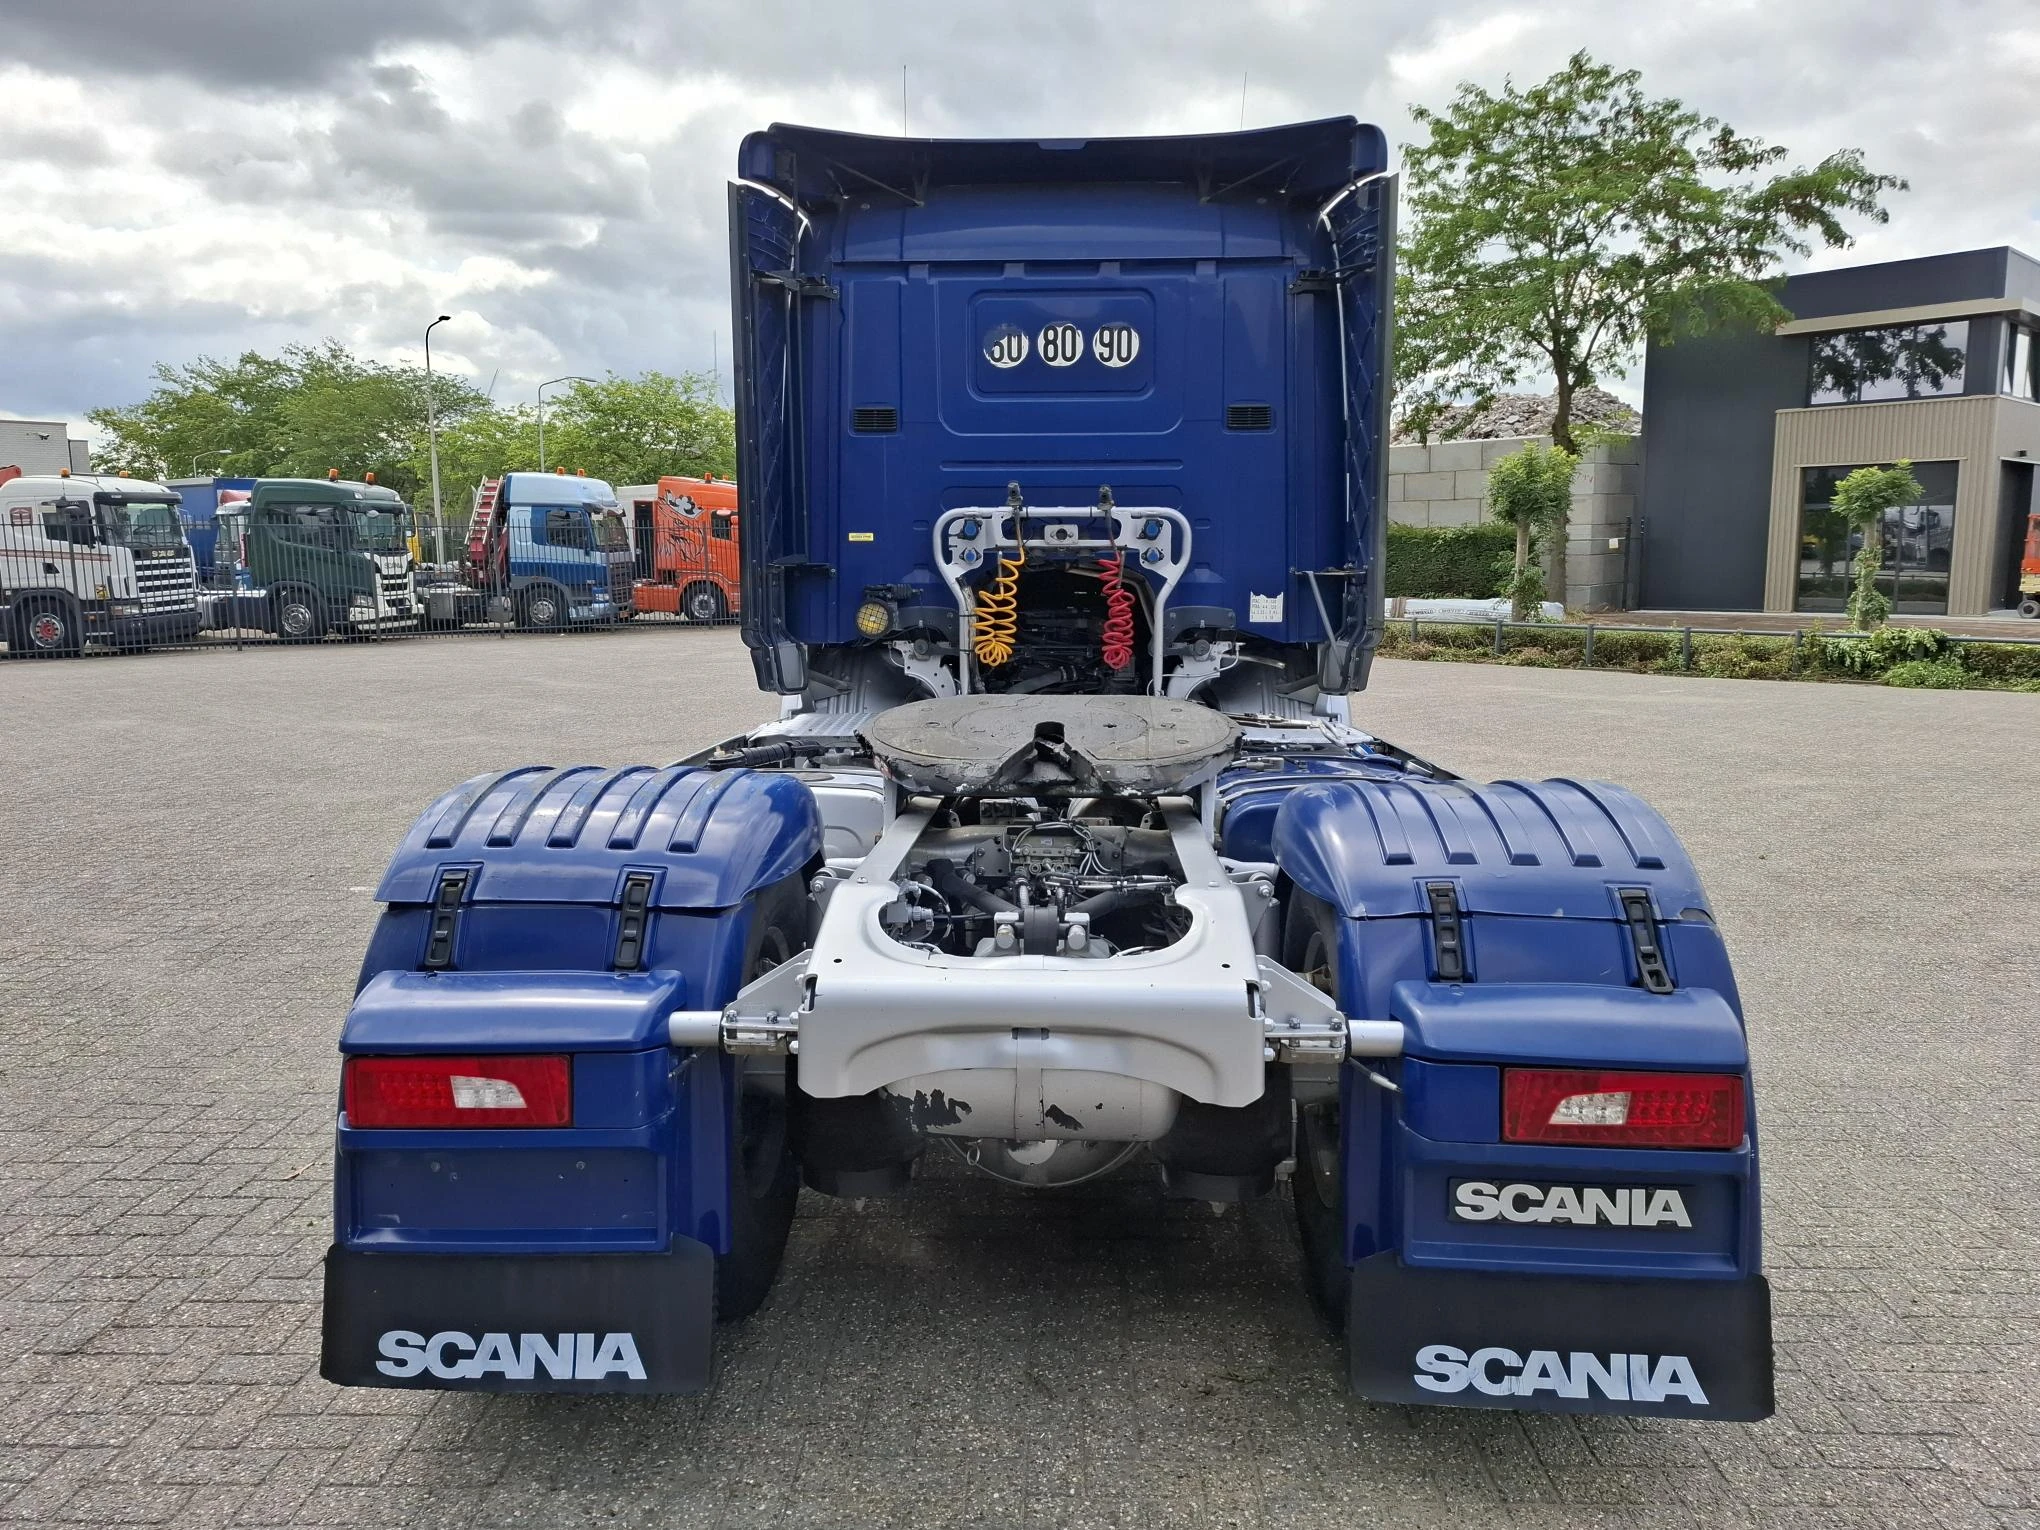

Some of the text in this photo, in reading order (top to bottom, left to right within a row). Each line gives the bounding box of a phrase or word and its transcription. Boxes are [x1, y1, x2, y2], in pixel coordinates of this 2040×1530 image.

[1043, 324, 1077, 363] 80
[1098, 325, 1133, 363] 90
[1454, 1182, 1693, 1229] SCANIA
[375, 1329, 648, 1380] SCANIA
[1412, 1344, 1710, 1406] SCANIA
